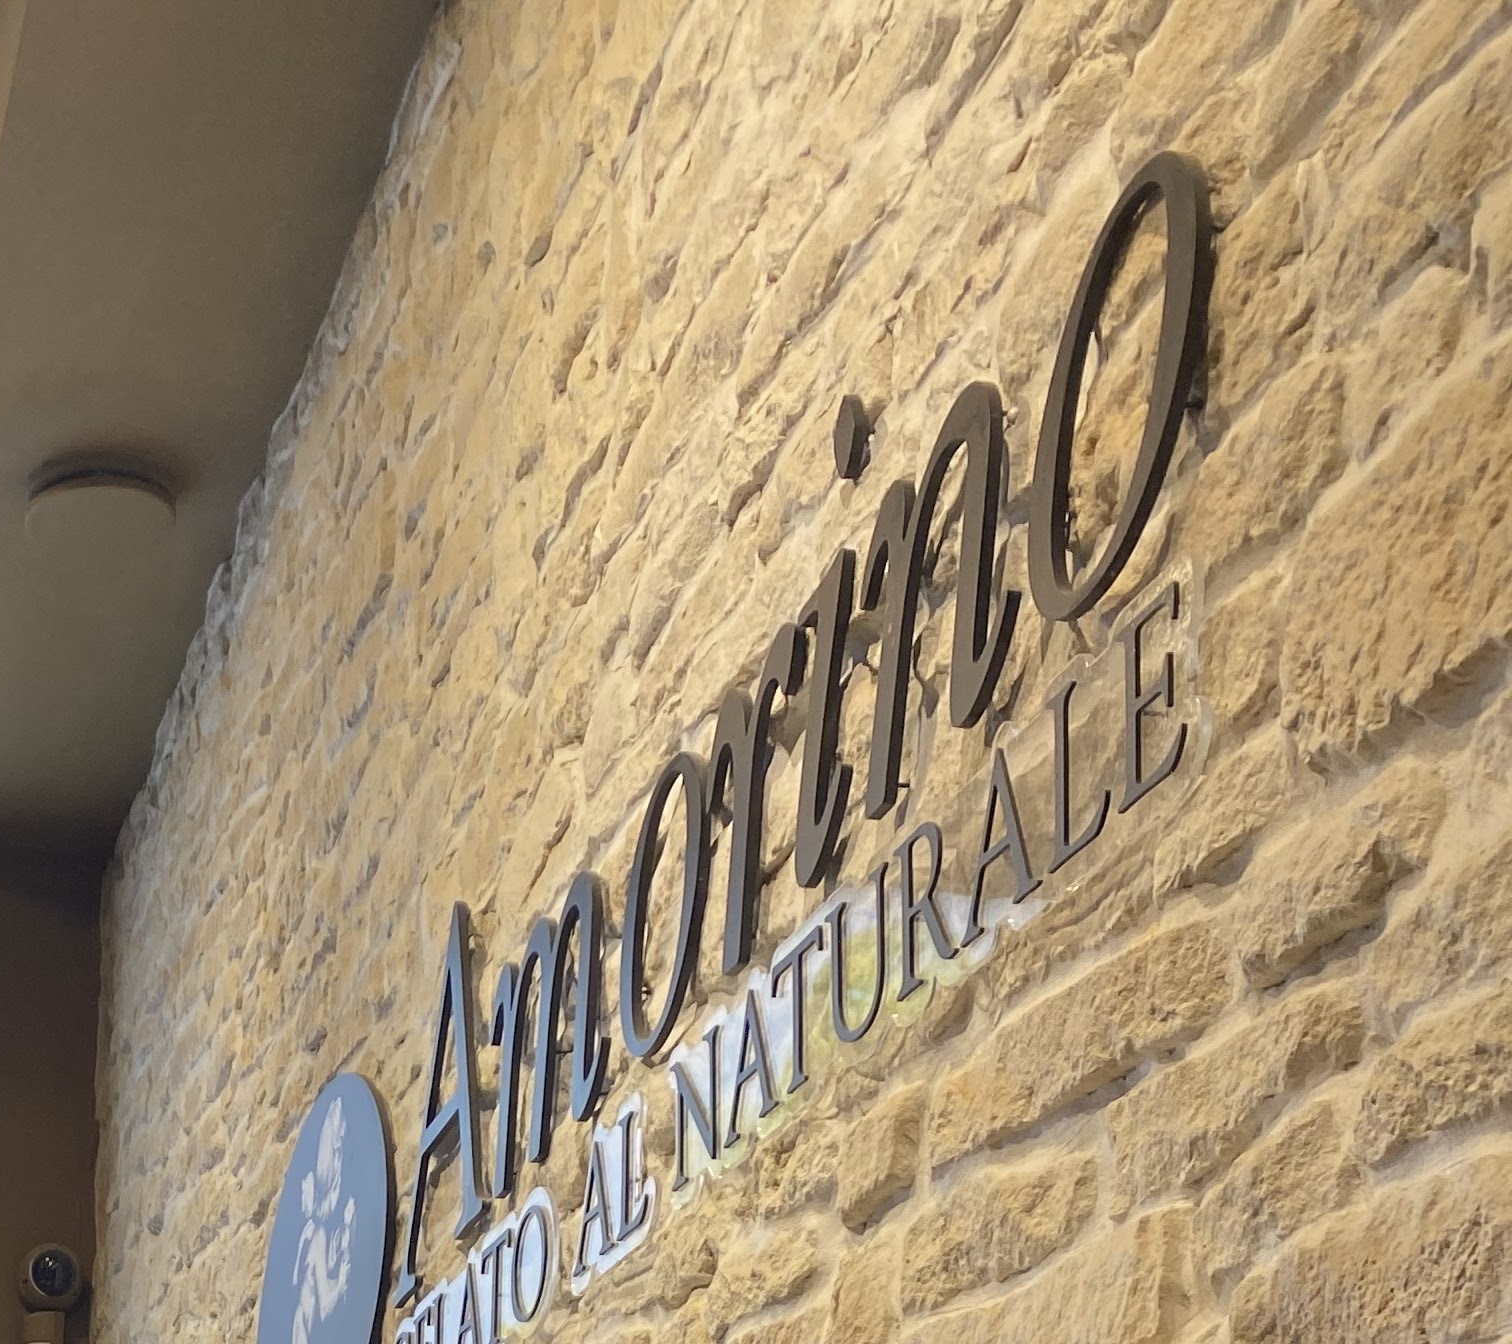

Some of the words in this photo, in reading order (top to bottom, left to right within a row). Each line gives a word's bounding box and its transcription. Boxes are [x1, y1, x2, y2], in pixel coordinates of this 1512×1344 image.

[393, 150, 1210, 1310] Amorino
[573, 1109, 650, 1279] AL
[672, 580, 1188, 1192] NATURALE
